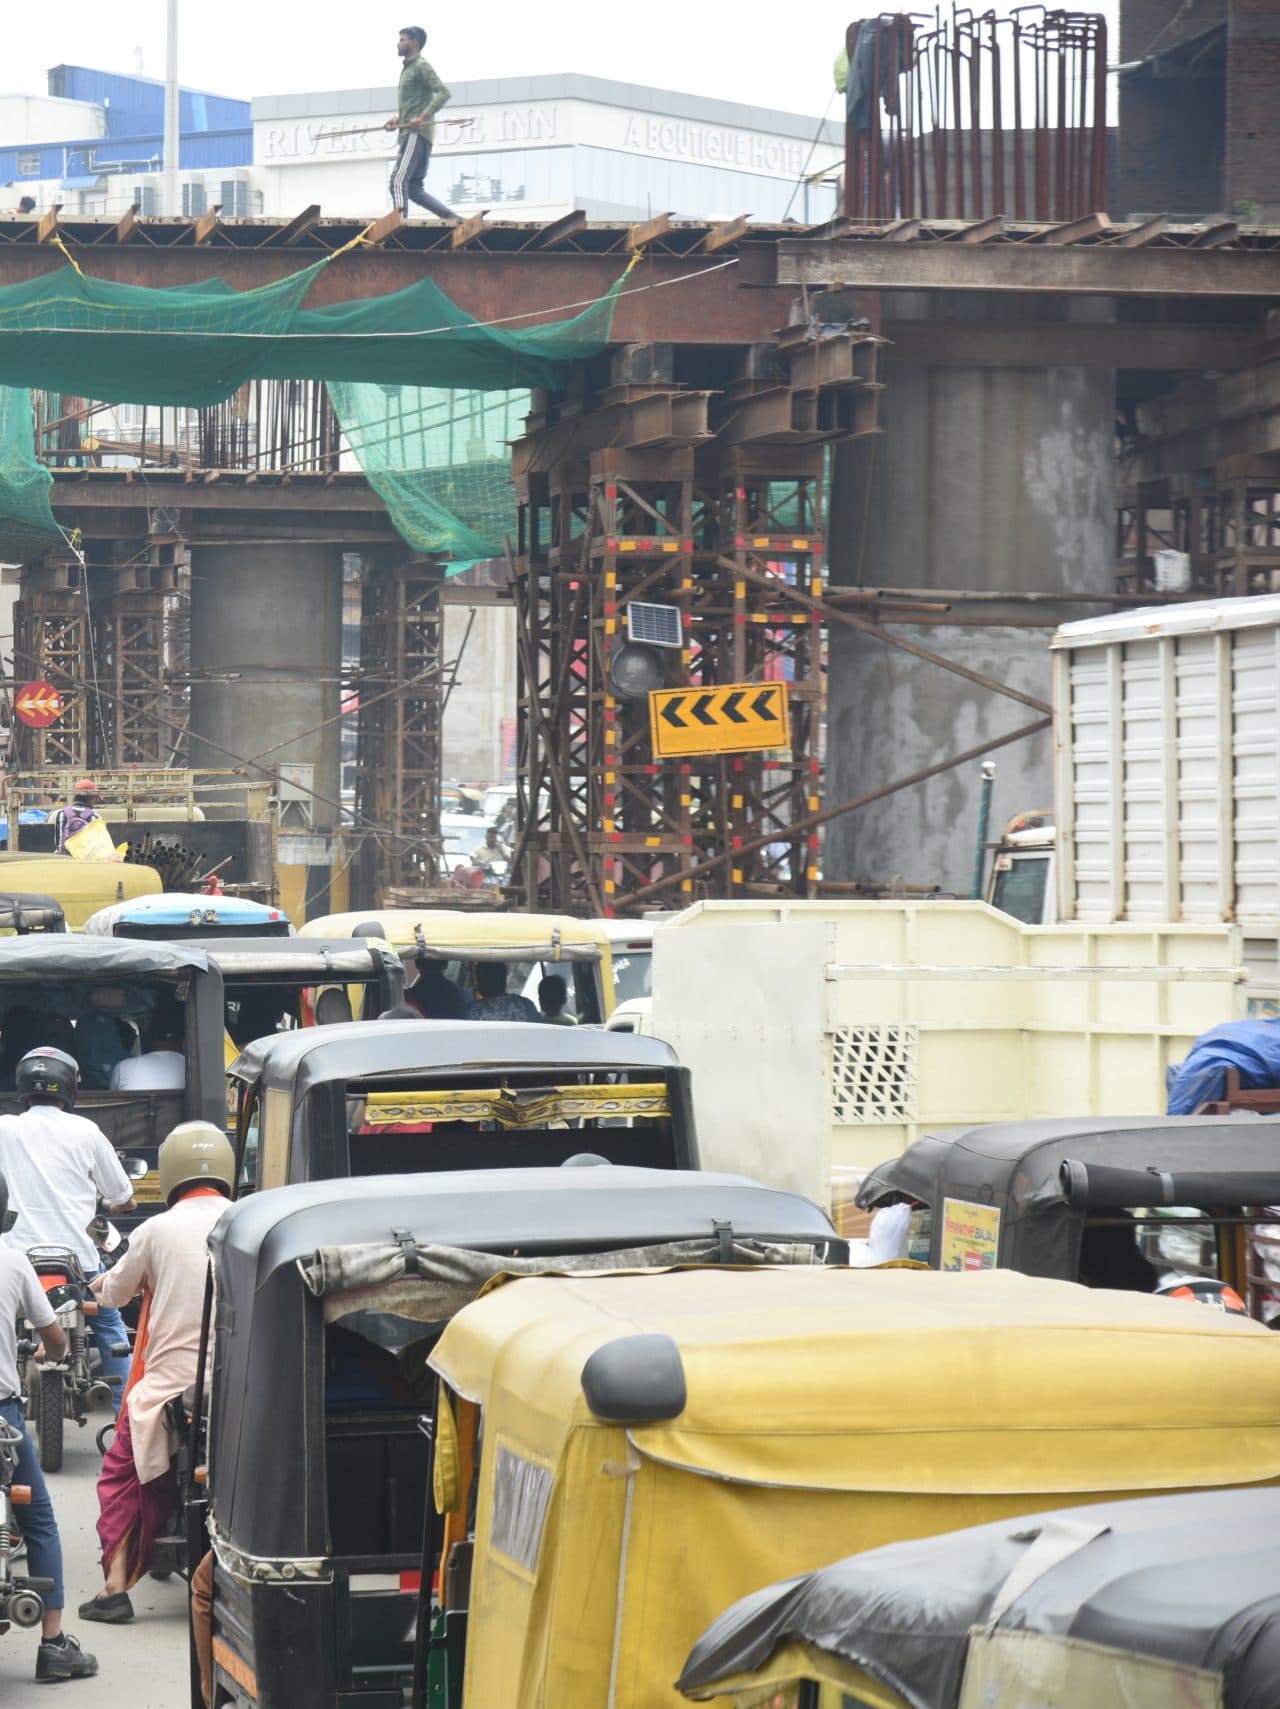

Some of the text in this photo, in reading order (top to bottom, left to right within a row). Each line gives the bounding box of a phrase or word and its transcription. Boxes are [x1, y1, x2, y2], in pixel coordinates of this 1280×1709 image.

[264, 118, 371, 159] RIVER
[495, 106, 559, 143] INN
[646, 117, 745, 166] BOUTIQUE
